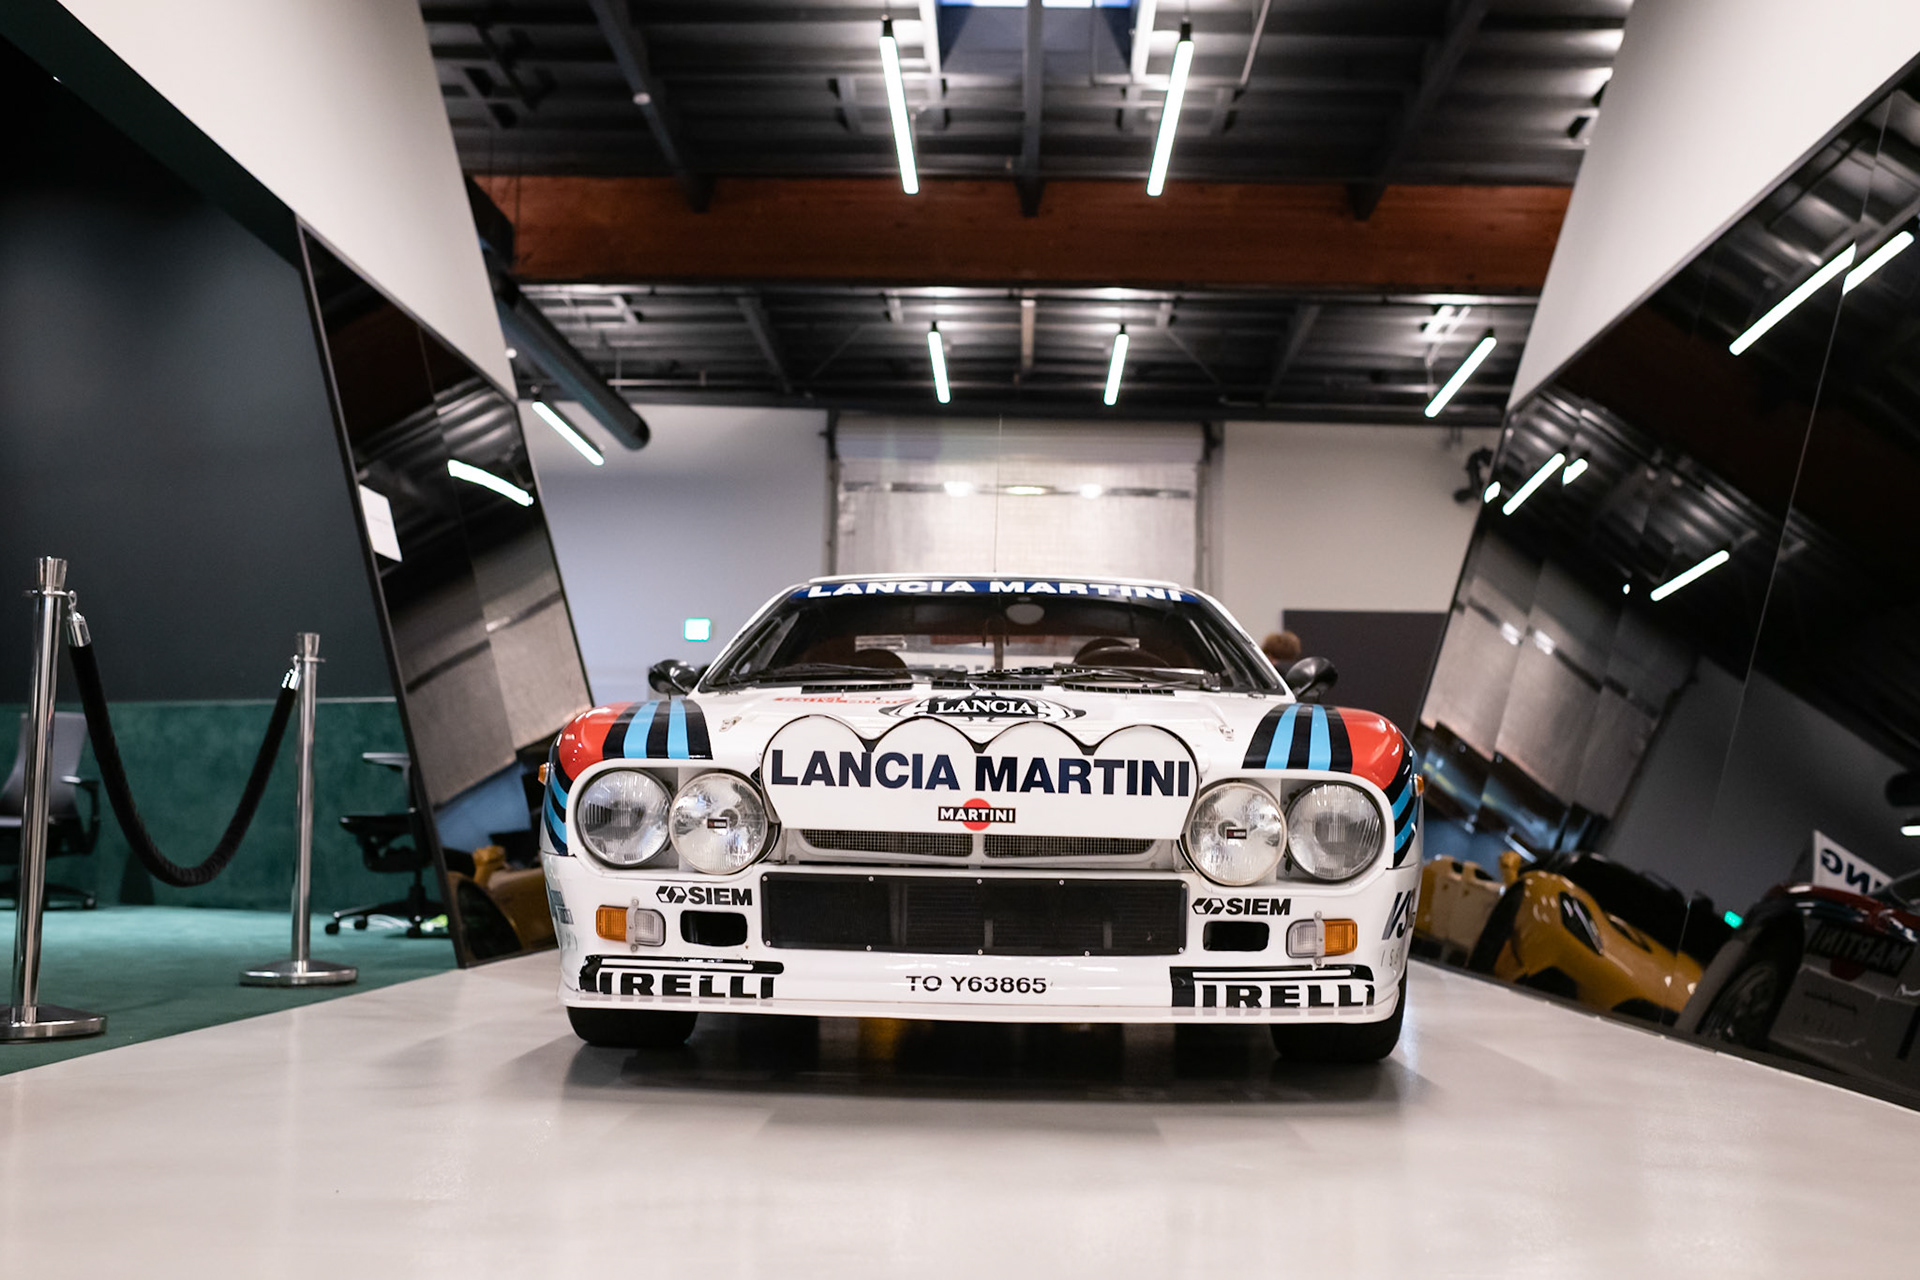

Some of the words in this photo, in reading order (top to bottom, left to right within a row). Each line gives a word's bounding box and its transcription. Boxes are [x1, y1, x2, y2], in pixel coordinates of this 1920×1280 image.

[807, 581, 976, 598] LANCIA
[989, 580, 1184, 602] MARTINI
[936, 699, 1035, 715] LANCIA
[771, 749, 960, 790] LANCIA
[975, 755, 1190, 797] MARTINI
[940, 807, 1015, 823] MARTINI
[688, 886, 753, 906] SIEM
[1227, 897, 1292, 916] SIEM
[905, 975, 943, 992] TO
[950, 976, 1047, 994] Y63865
